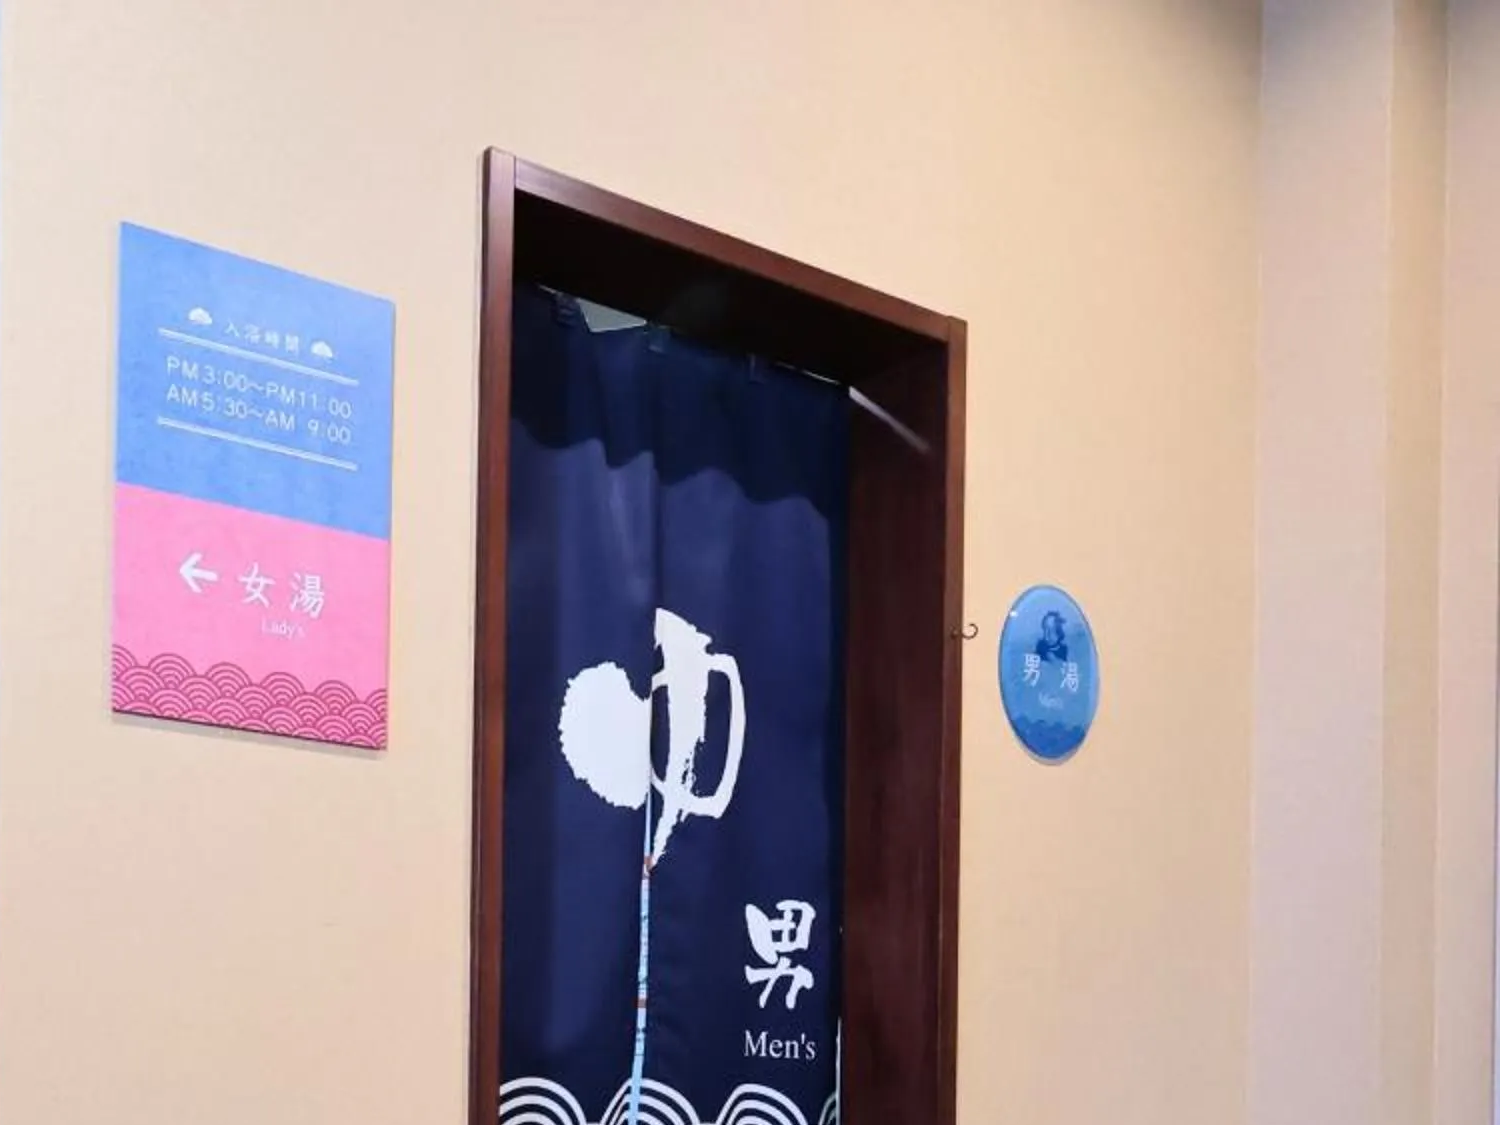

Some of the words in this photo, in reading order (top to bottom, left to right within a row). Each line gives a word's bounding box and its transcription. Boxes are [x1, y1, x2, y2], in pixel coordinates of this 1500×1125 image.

[238, 561, 325, 618] 女湯
[1022, 653, 1079, 692] 男湯
[745, 900, 816, 1009] 男
[743, 1029, 816, 1059] Men's
